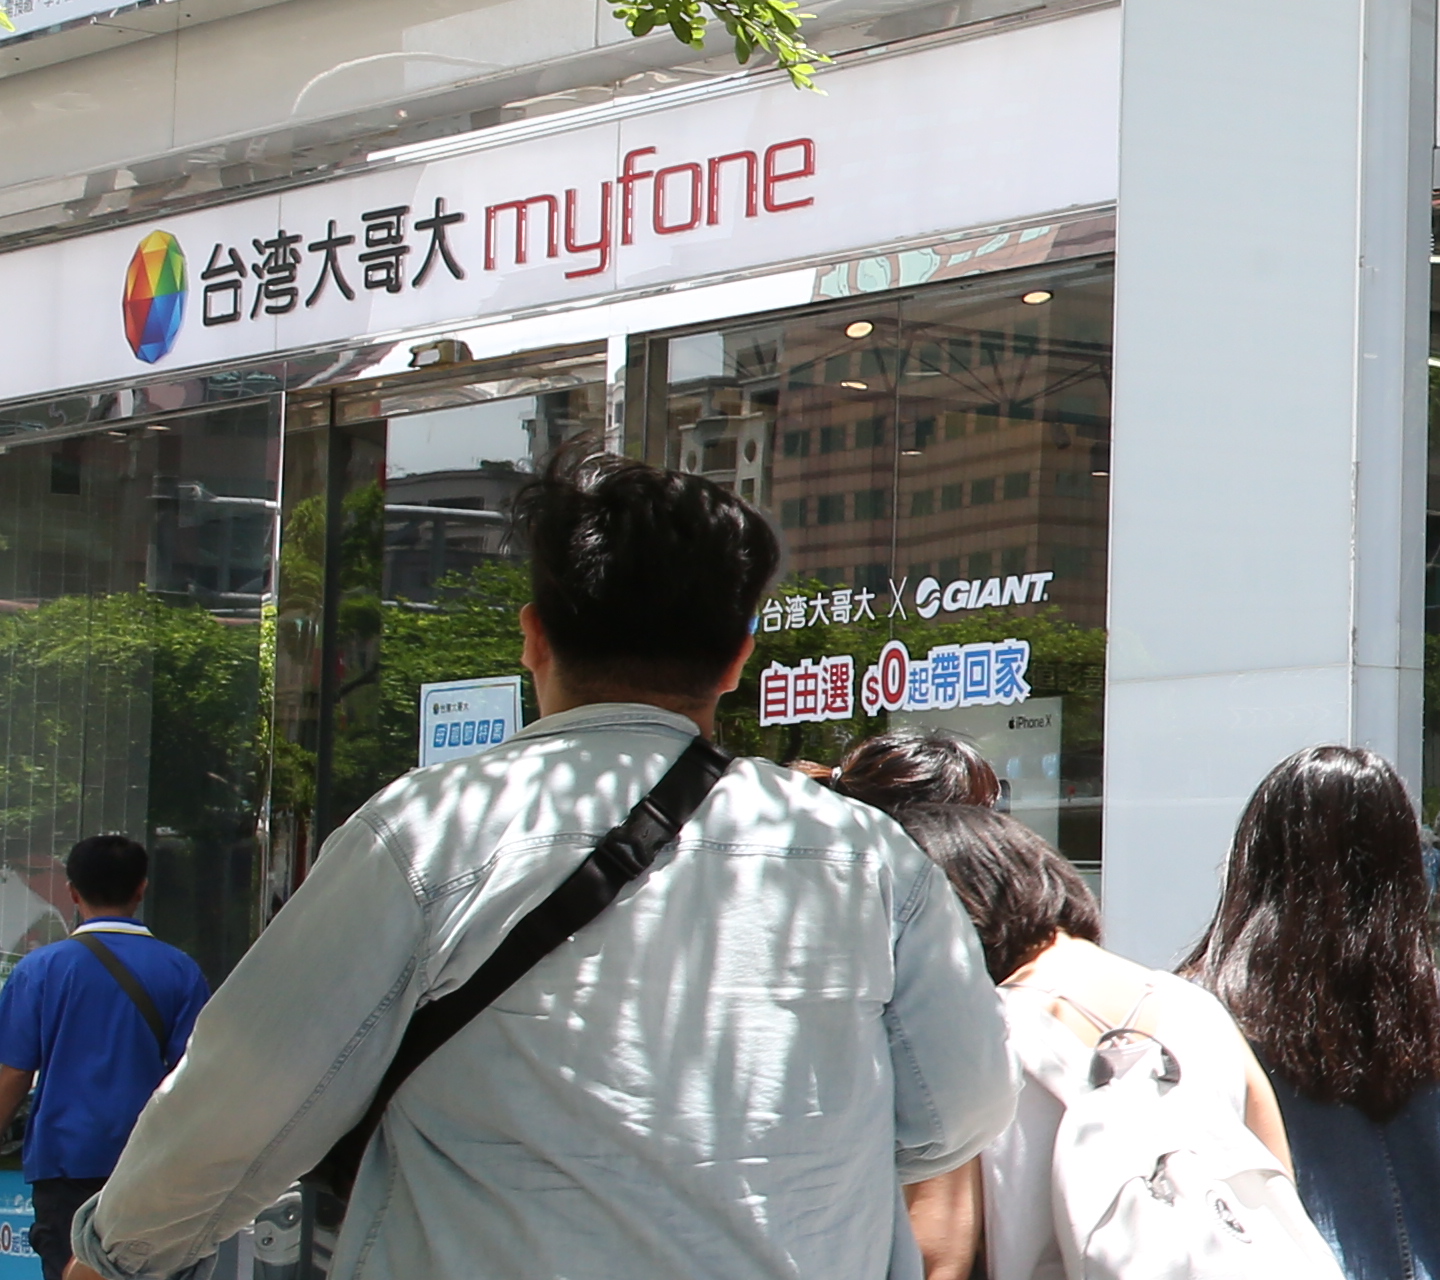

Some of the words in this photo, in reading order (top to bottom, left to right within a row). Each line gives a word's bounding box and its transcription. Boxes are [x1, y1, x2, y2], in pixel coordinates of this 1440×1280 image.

[482, 136, 816, 280] myfone
[942, 571, 1054, 613] GIANT
[763, 661, 850, 719] 自由選
[863, 646, 1028, 710] $0起帶回家
[1015, 715, 1044, 730] iPhone
